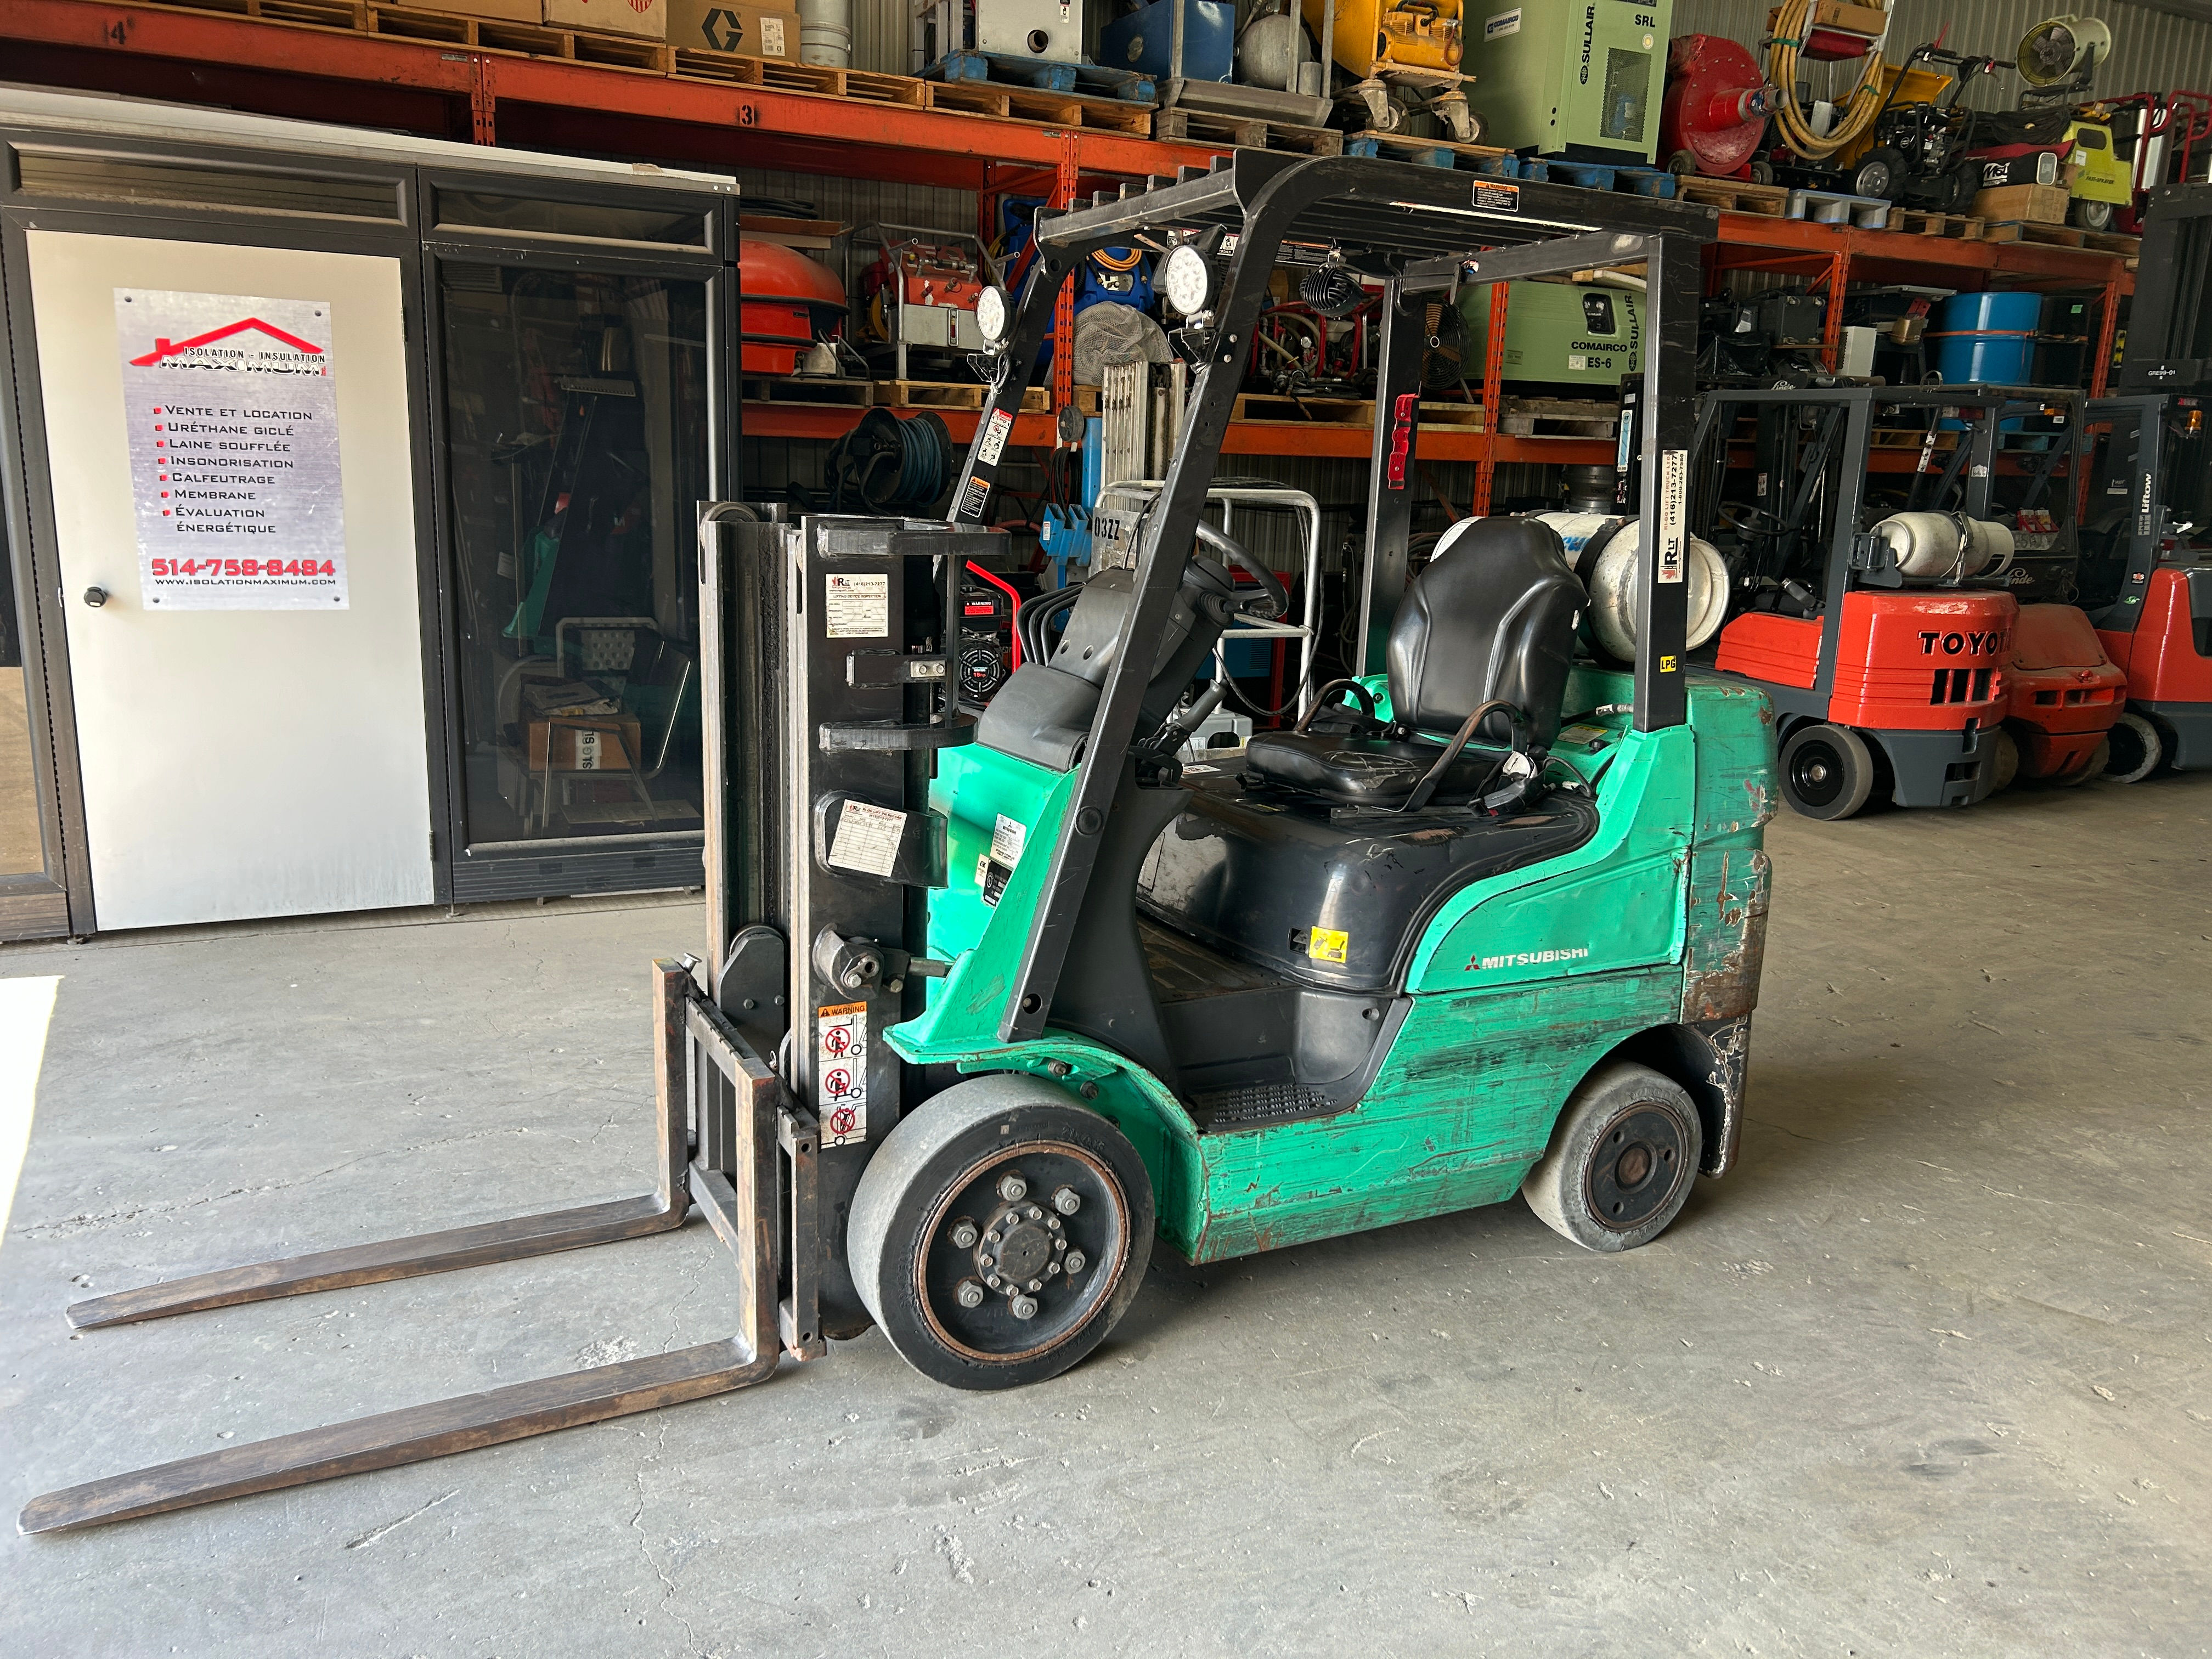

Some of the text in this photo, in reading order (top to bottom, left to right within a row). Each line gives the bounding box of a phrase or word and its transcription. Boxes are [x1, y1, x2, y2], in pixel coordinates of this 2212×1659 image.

[1634, 14, 1656, 27] SRL
[1582, 5, 1595, 63] SULLAIR
[741, 105, 754, 125] 3
[1624, 295, 1639, 349] SULLAIR
[1571, 341, 1627, 352] COMAIRCO
[184, 347, 244, 358] ISOLATION
[260, 352, 325, 363] INSULATION
[160, 356, 320, 376] MAXIMUM
[1587, 357, 1612, 369] ES-6
[165, 405, 313, 420] VENTE ET LOCATION
[168, 421, 294, 436] URÉTHANE GICLÉ
[169, 438, 291, 452] LAINE SOUFFLÉE
[171, 455, 294, 469] INSONORISATION
[172, 472, 275, 484] CALFEUTRAGE
[174, 489, 256, 500] MEMBRANE
[1669, 454, 1678, 526] (416)213-7277
[2142, 472, 2152, 513] Liftow
[176, 504, 265, 518] ÉVALUATION
[177, 521, 276, 534] ÉNERGÉTIQUE
[1664, 538, 1677, 565] RLT
[151, 558, 336, 577] 514-758-8484
[1661, 659, 1675, 669] LPG
[1482, 948, 1588, 969] MITSUBISHI
[831, 1005, 865, 1015] WARNING
